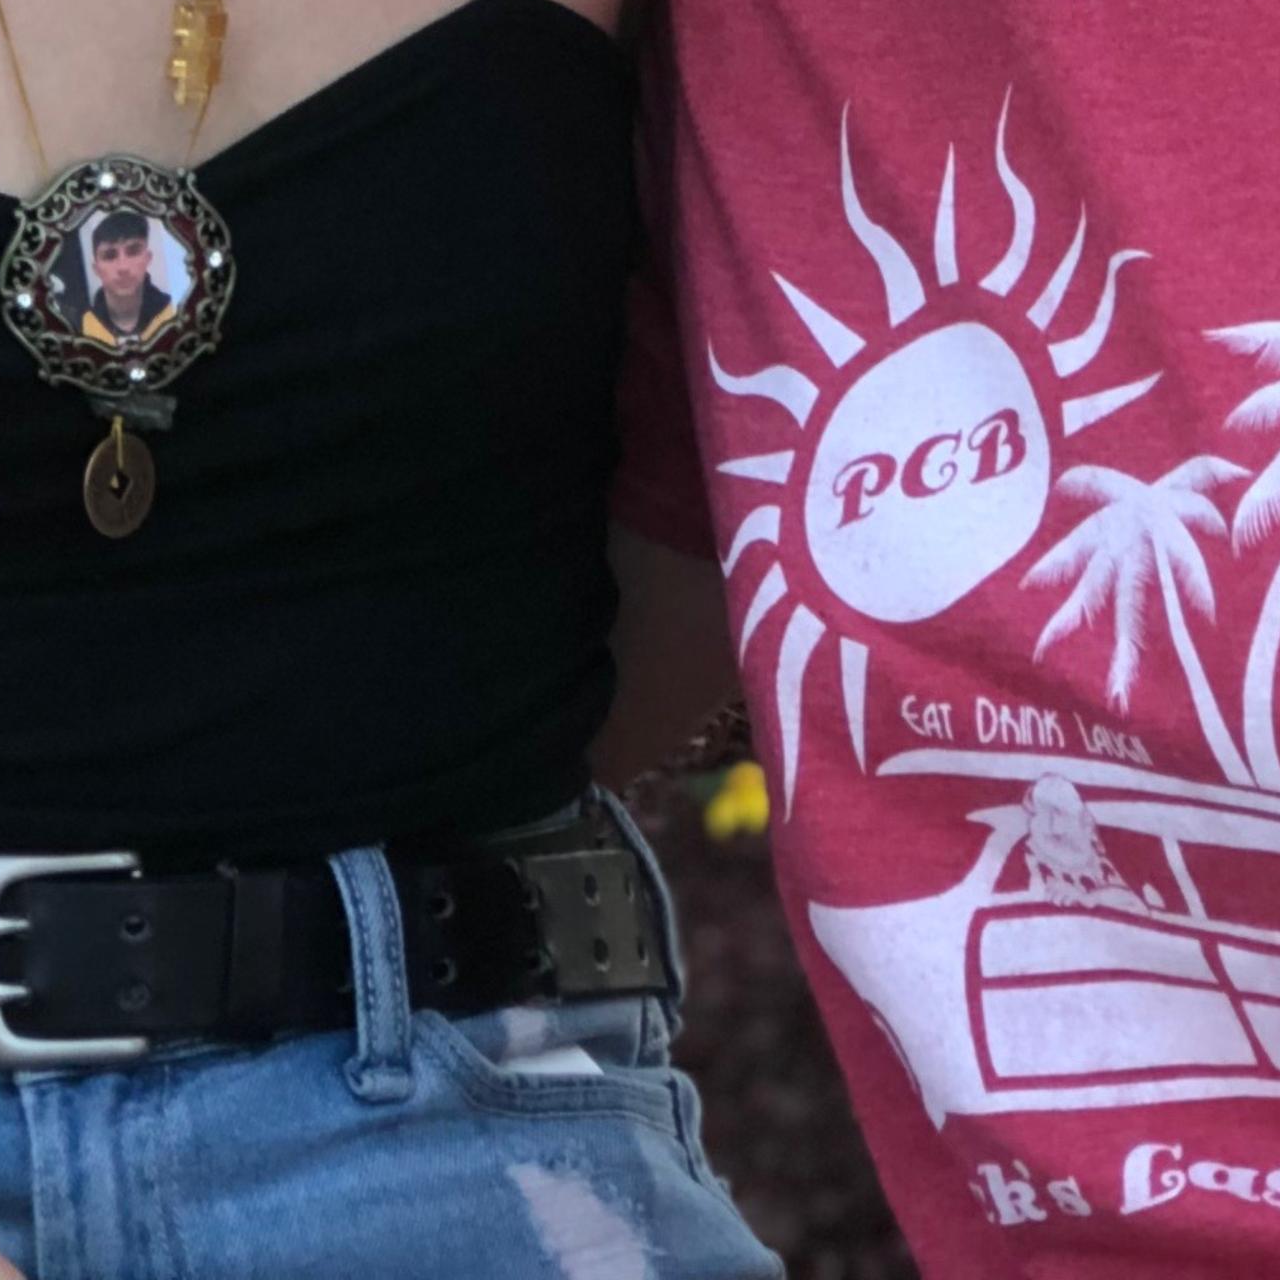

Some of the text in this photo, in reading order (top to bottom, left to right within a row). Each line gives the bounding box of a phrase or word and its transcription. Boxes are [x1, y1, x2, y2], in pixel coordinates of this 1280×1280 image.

[832, 407, 1027, 529] PCB
[900, 693, 955, 741] EAT
[975, 695, 1065, 749] DRINK
